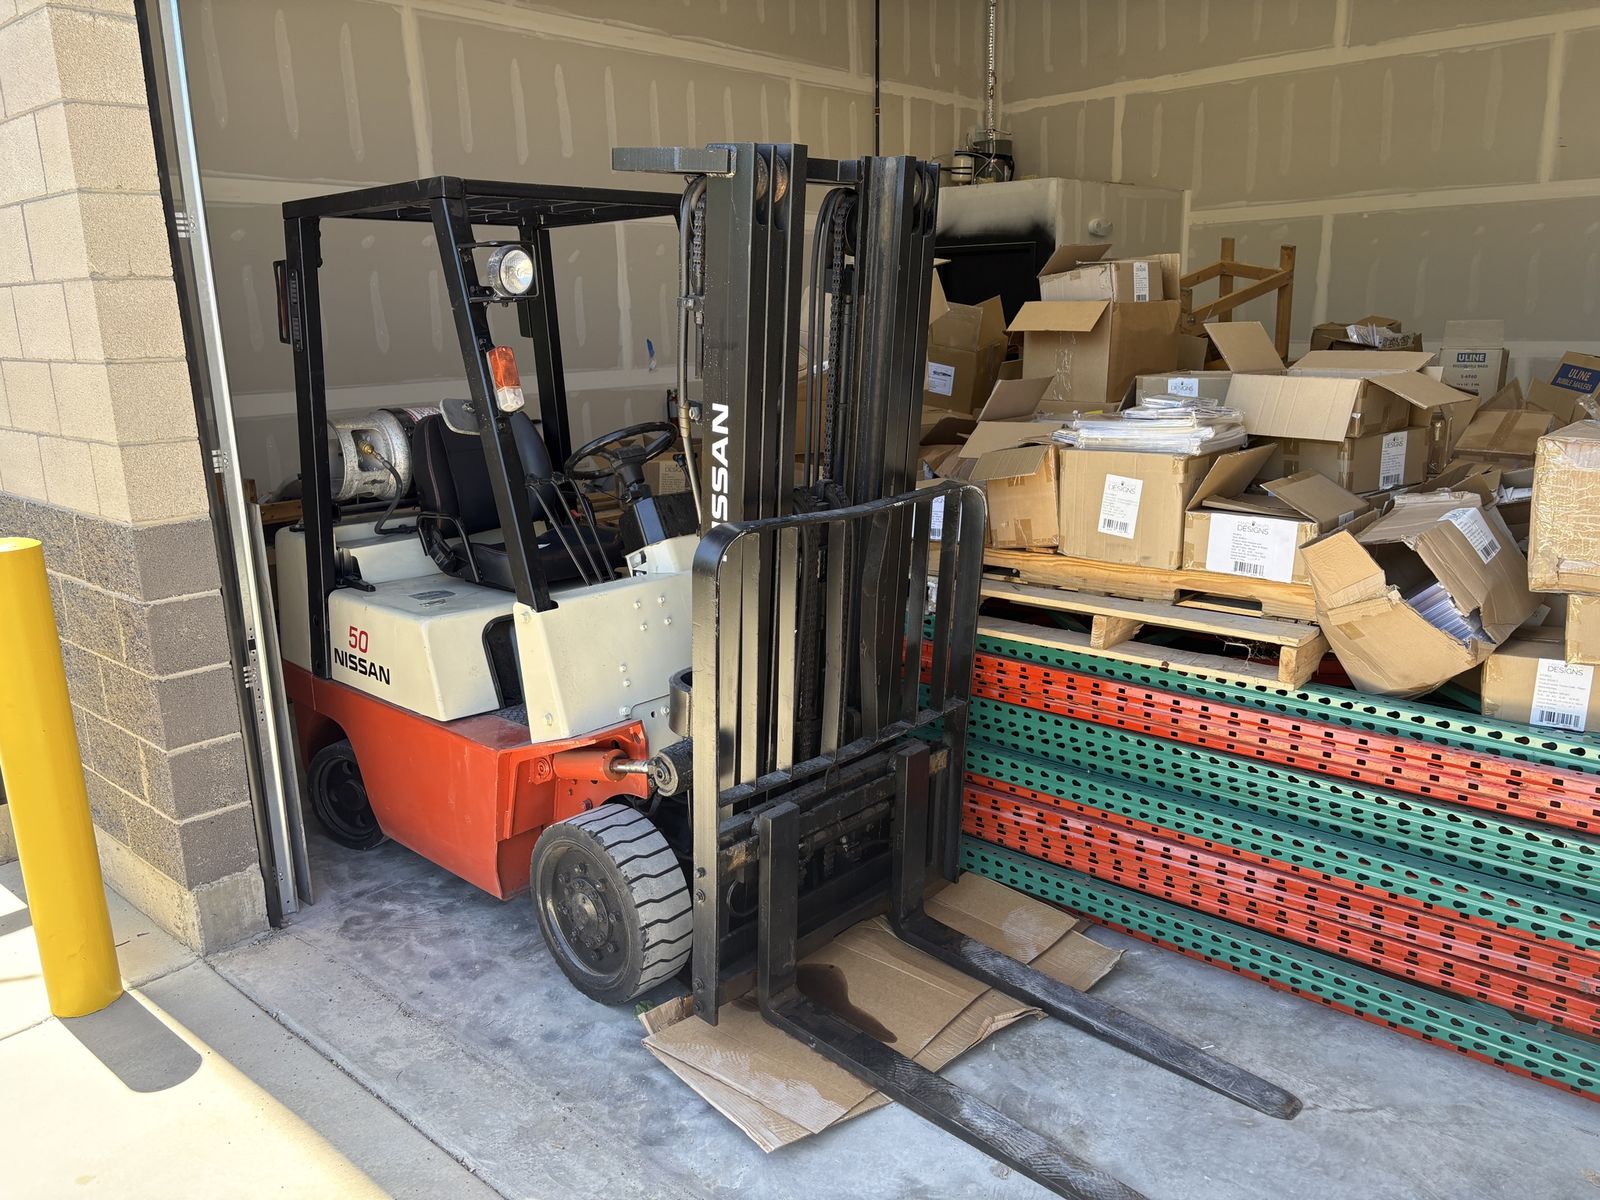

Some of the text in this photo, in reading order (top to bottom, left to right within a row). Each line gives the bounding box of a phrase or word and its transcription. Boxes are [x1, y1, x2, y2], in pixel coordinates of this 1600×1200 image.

[1458, 353, 1486, 362] ULINE
[1568, 368, 1593, 382] ULINE
[1384, 441, 1404, 449] DESIGNS
[1107, 483, 1137, 495] DESIGNS
[1236, 524, 1270, 536] DESIGNS
[348, 625, 369, 653] 50
[334, 647, 391, 686] NISSAN
[1547, 665, 1584, 677] DESIGNS
